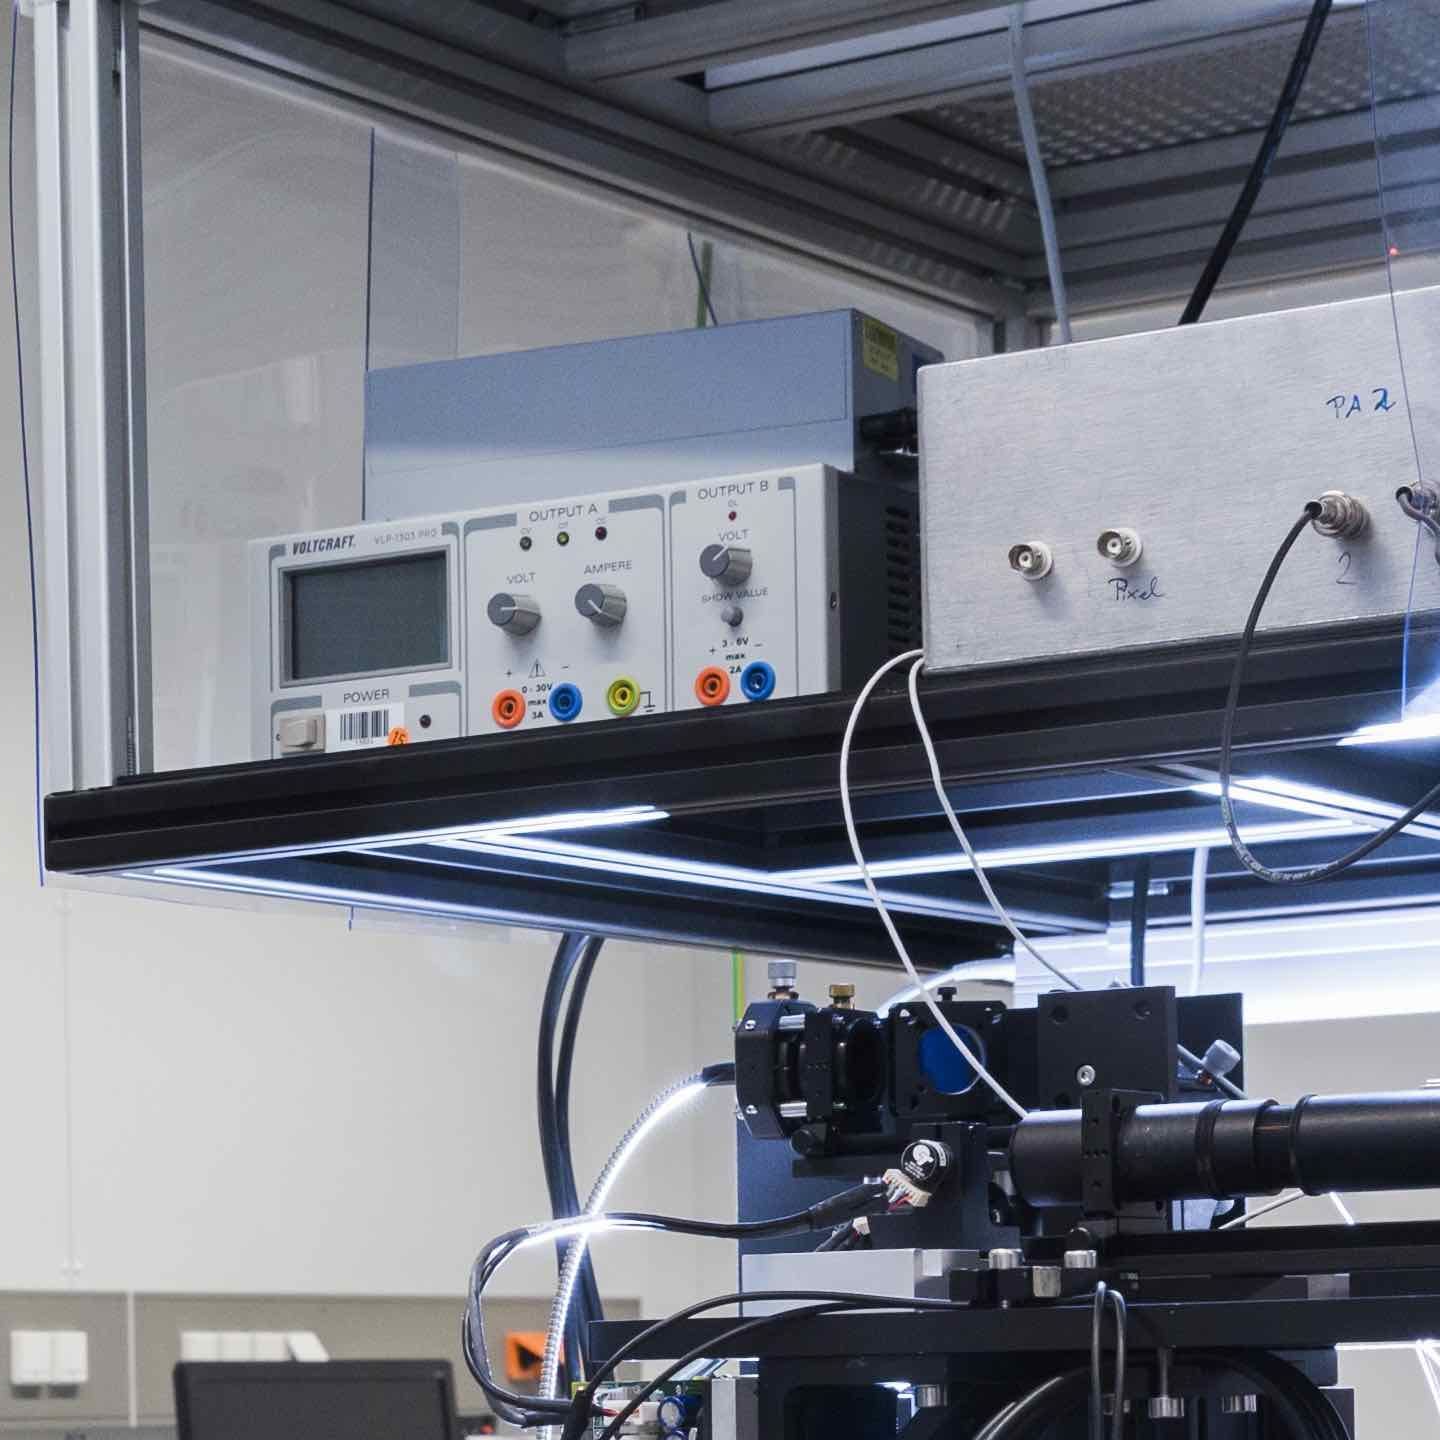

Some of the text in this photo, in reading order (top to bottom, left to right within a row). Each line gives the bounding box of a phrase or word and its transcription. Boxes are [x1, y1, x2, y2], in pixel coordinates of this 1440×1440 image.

[1371, 386, 1397, 412] 2
[696, 479, 769, 501] OUTPUT B
[528, 503, 584, 523] OUTPUT
[587, 502, 599, 515] A
[718, 528, 750, 543] VOLT
[292, 535, 356, 557] VOLTCRAFT
[583, 558, 634, 576] AMPERE
[505, 571, 537, 587] VOLT
[701, 586, 770, 603] SHOW VALUE
[1107, 574, 1165, 602] Pixel
[725, 652, 746, 662] max
[729, 665, 742, 675] 2A
[342, 688, 390, 704] POWER
[527, 698, 547, 707] max
[531, 711, 544, 721] 3A
